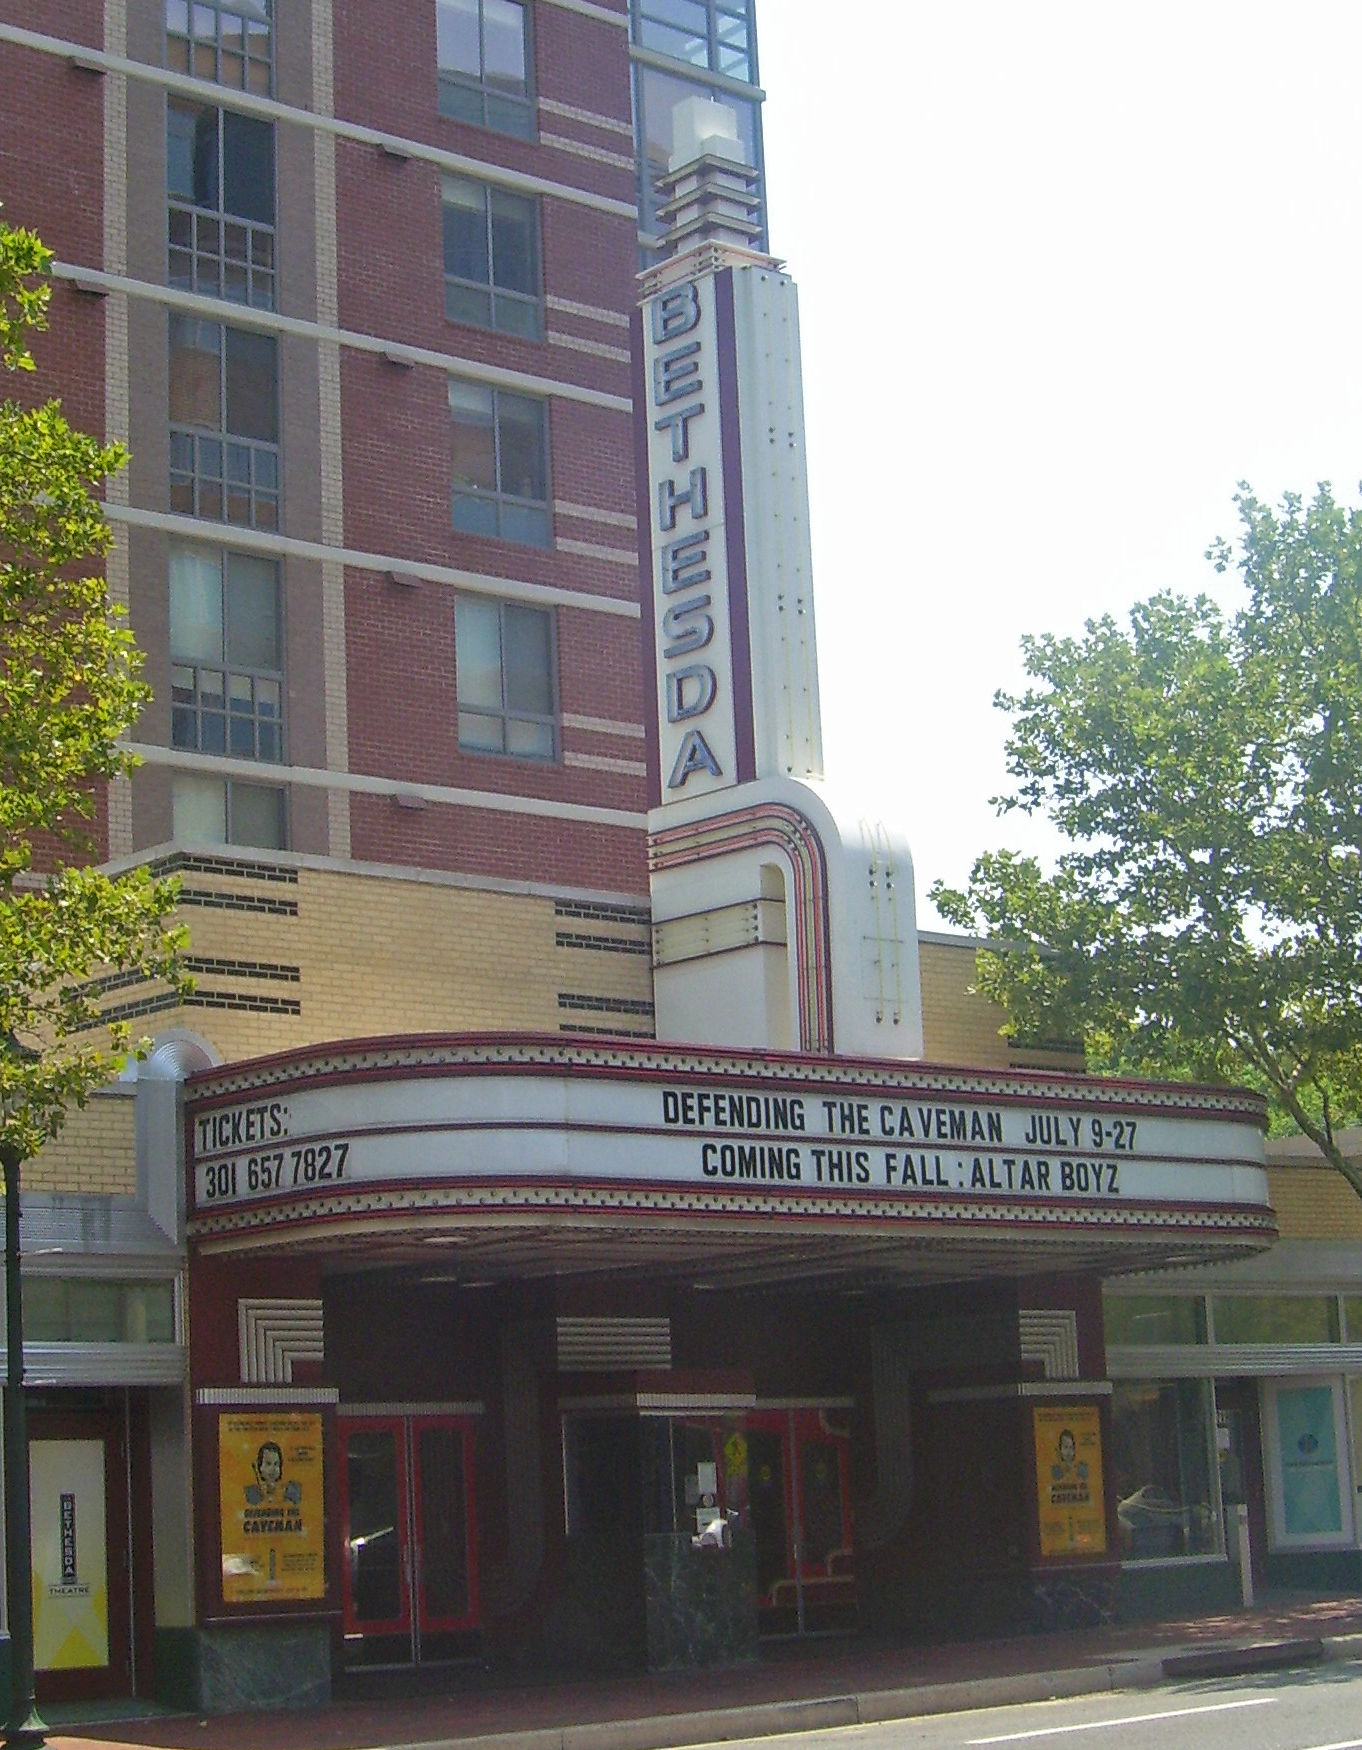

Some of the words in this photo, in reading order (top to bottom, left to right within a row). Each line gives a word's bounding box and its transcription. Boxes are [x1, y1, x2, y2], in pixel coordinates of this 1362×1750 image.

[651, 279, 723, 790] BETHESDA
[198, 1102, 289, 1151] TICKETS:
[662, 1090, 806, 1132] DEFENDING
[822, 1100, 871, 1136] THE
[879, 1103, 1003, 1143] CAVEMAN
[1025, 1114, 1082, 1147] JULY
[1091, 1117, 1138, 1151] 9-27
[205, 1162, 237, 1199] 301
[247, 1152, 285, 1192] 657
[290, 1142, 350, 1185] 7827
[701, 1143, 802, 1181] COMING
[811, 1149, 871, 1184] THIS
[1060, 1160, 1120, 1194] BOYZ
[63, 1501, 74, 1575] BETHESDA
[243, 1518, 302, 1534] CAVEMAN
[49, 1586, 91, 1595] THEATRE
